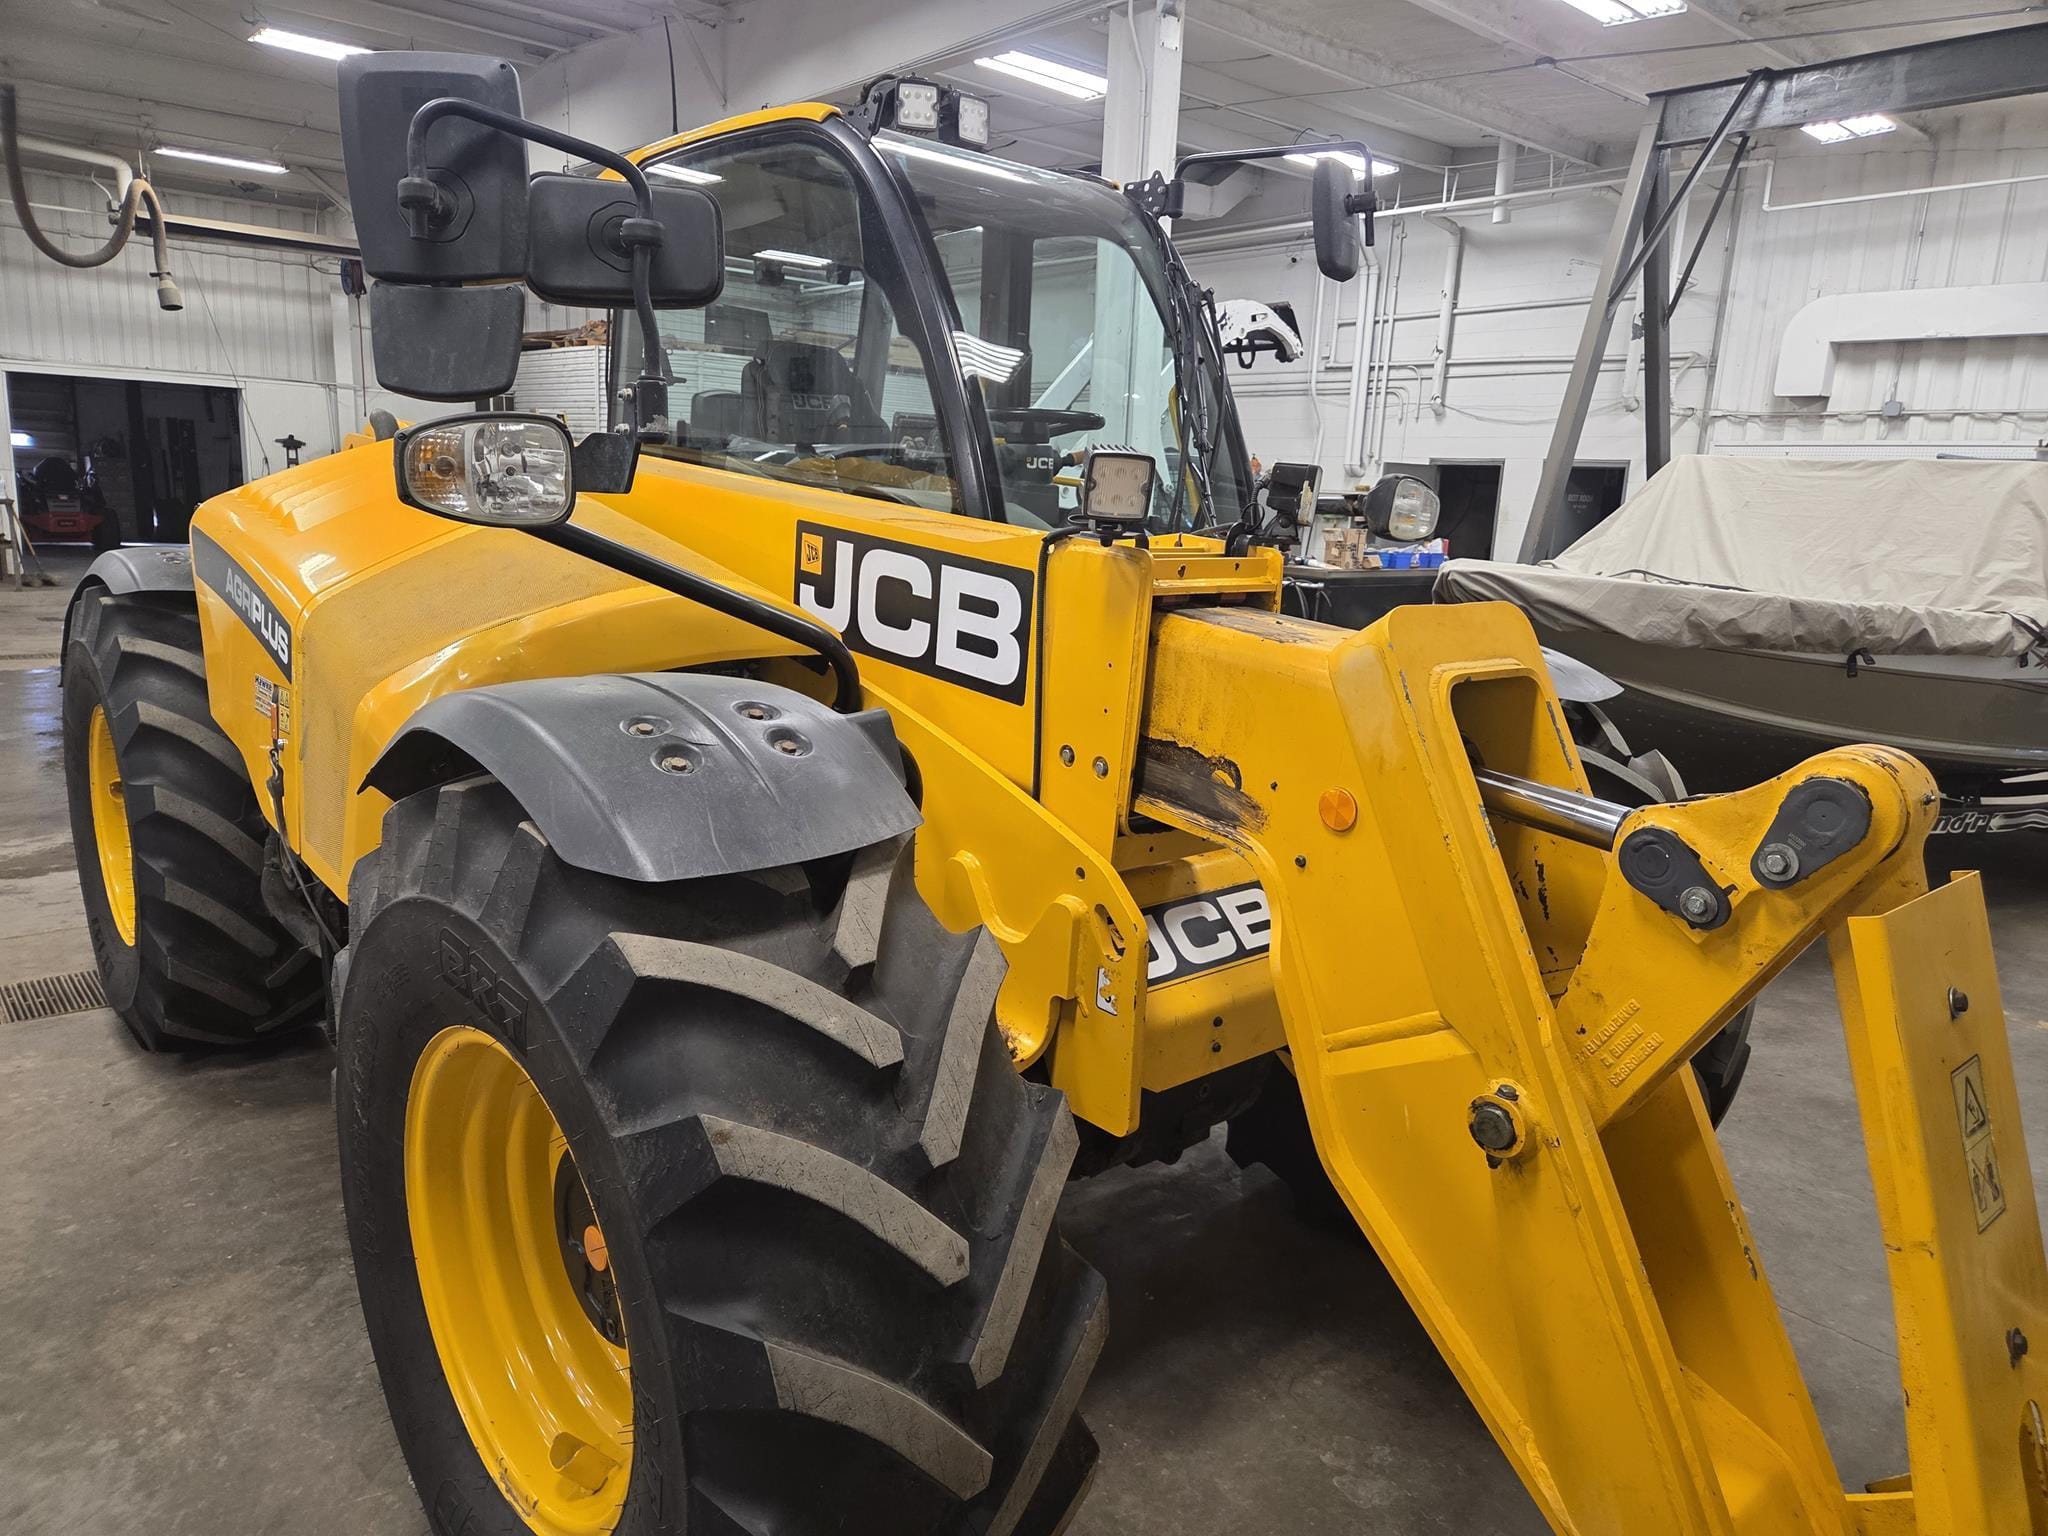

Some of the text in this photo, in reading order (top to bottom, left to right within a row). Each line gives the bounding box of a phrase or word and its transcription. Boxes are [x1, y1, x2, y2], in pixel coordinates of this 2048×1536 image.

[806, 543, 819, 562] JCB
[800, 540, 1022, 686] JCB
[1147, 888, 1271, 980] JCB
